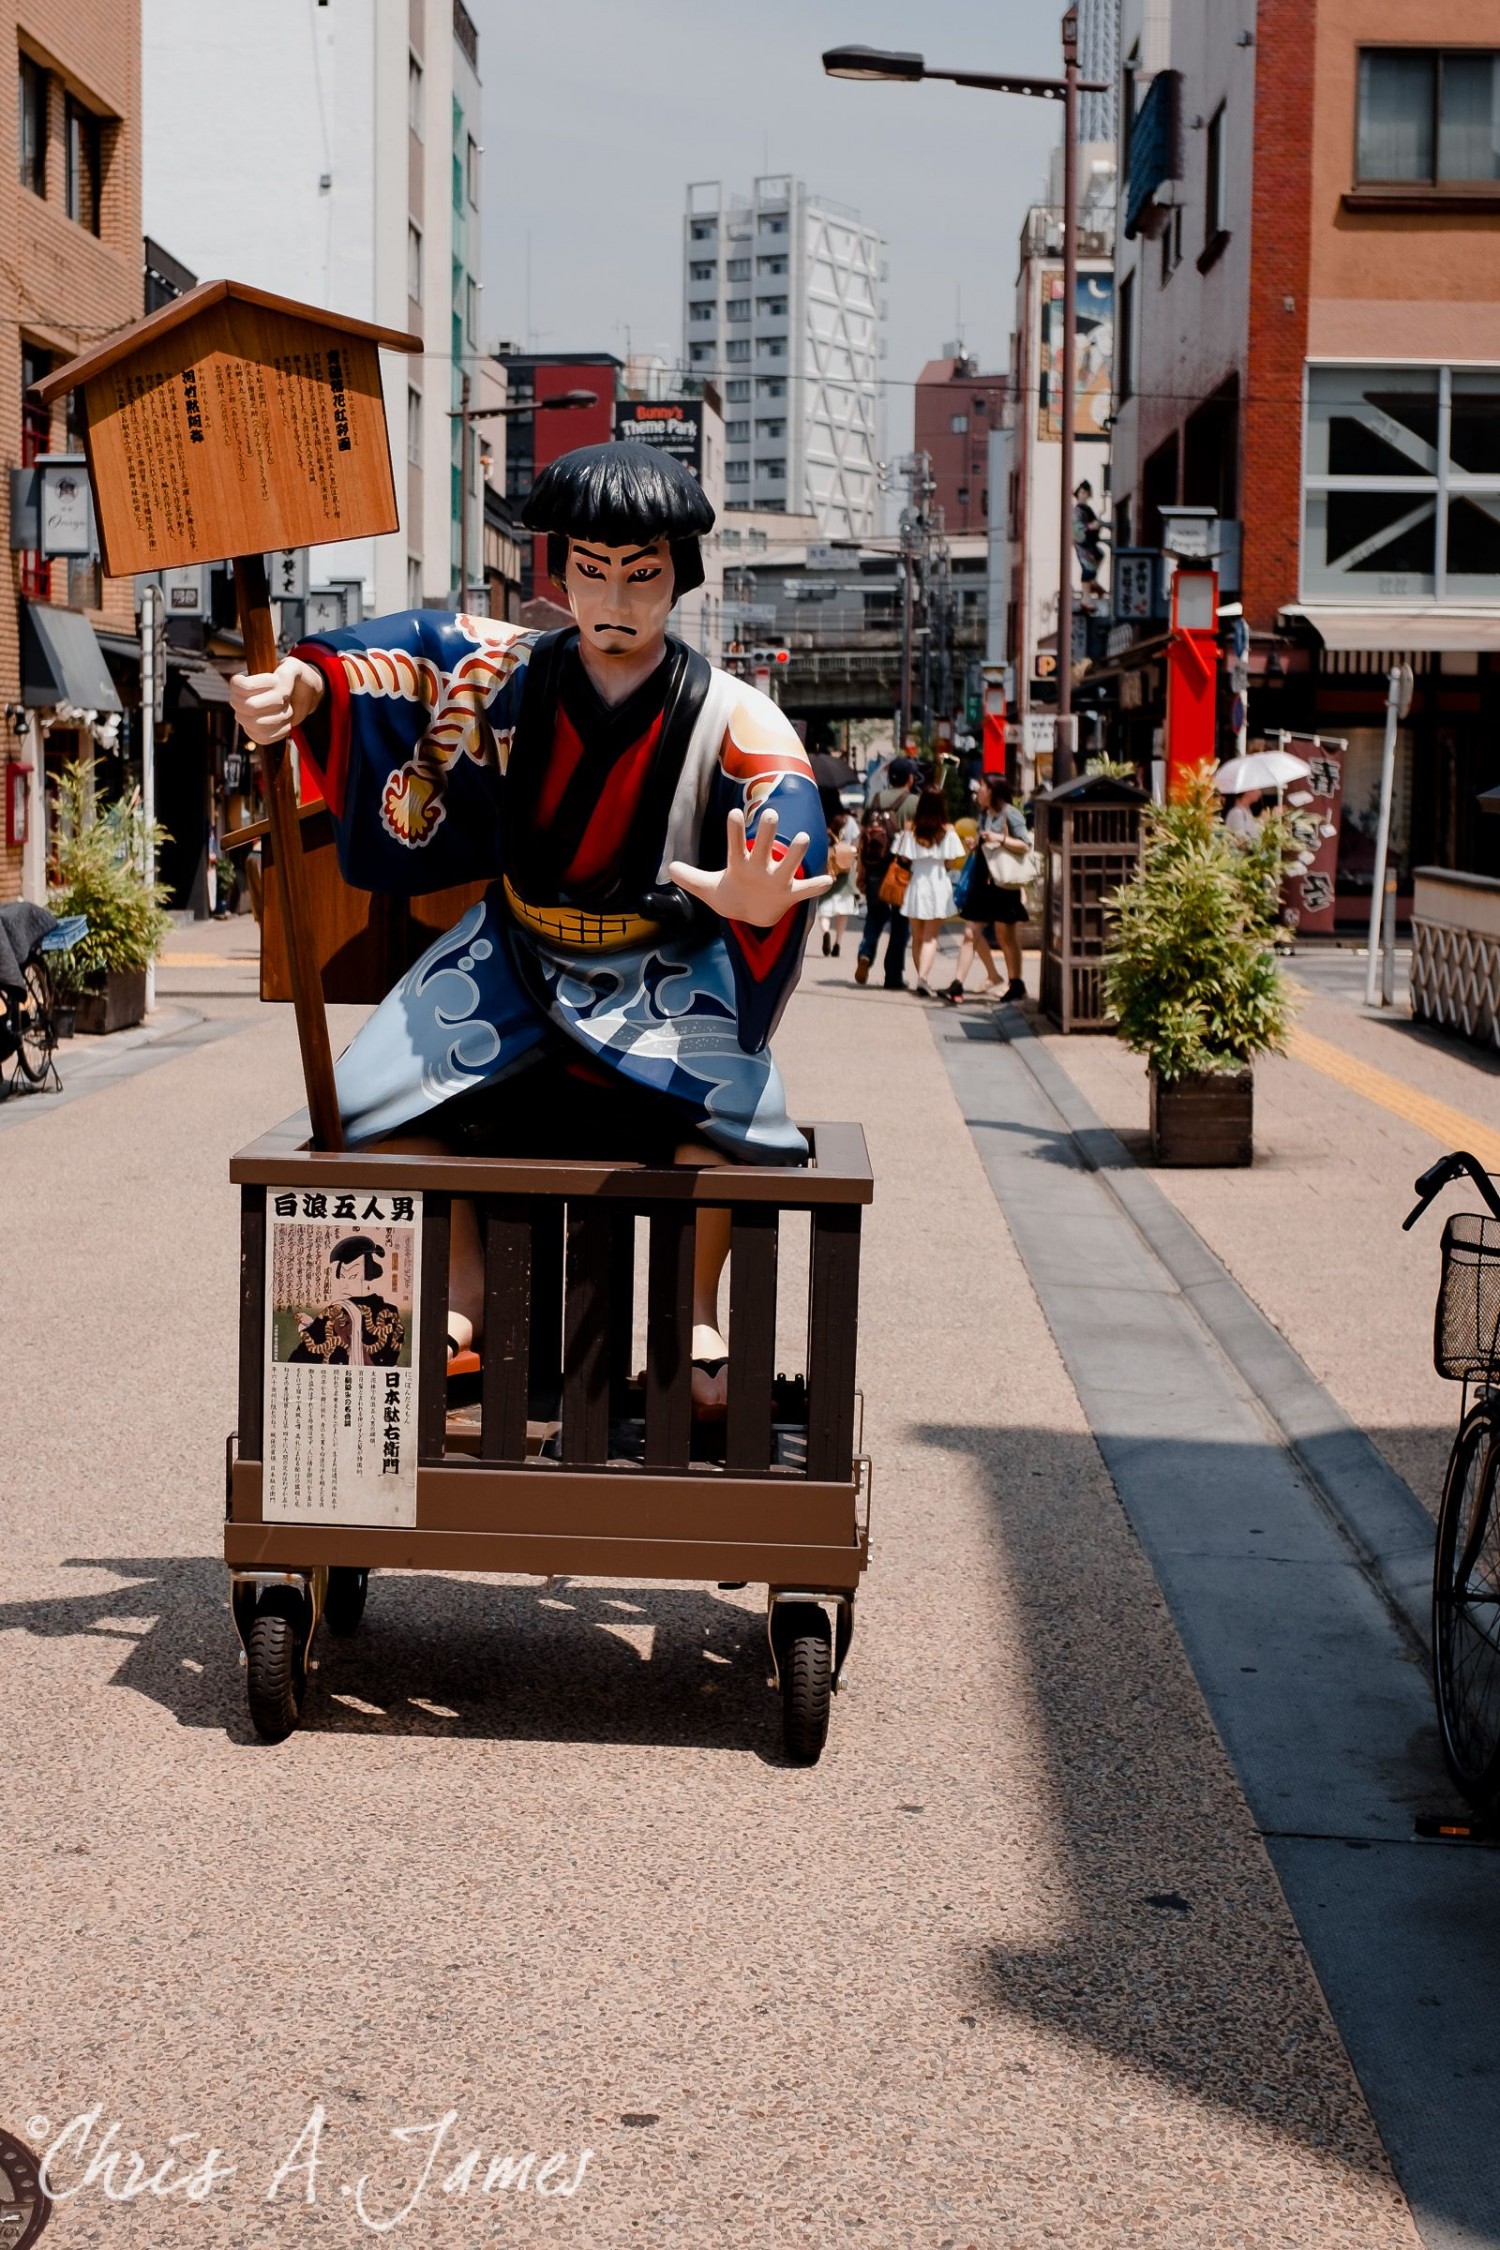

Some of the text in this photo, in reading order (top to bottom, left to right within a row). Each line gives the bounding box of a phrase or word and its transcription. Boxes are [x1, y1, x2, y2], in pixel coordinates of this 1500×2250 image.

[636, 405, 684, 420] Bunny's
[620, 418, 697, 437] Theme Park
[274, 1192, 415, 1222] 白浪五人男
[382, 1372, 401, 1475] 日本駄右衛門
